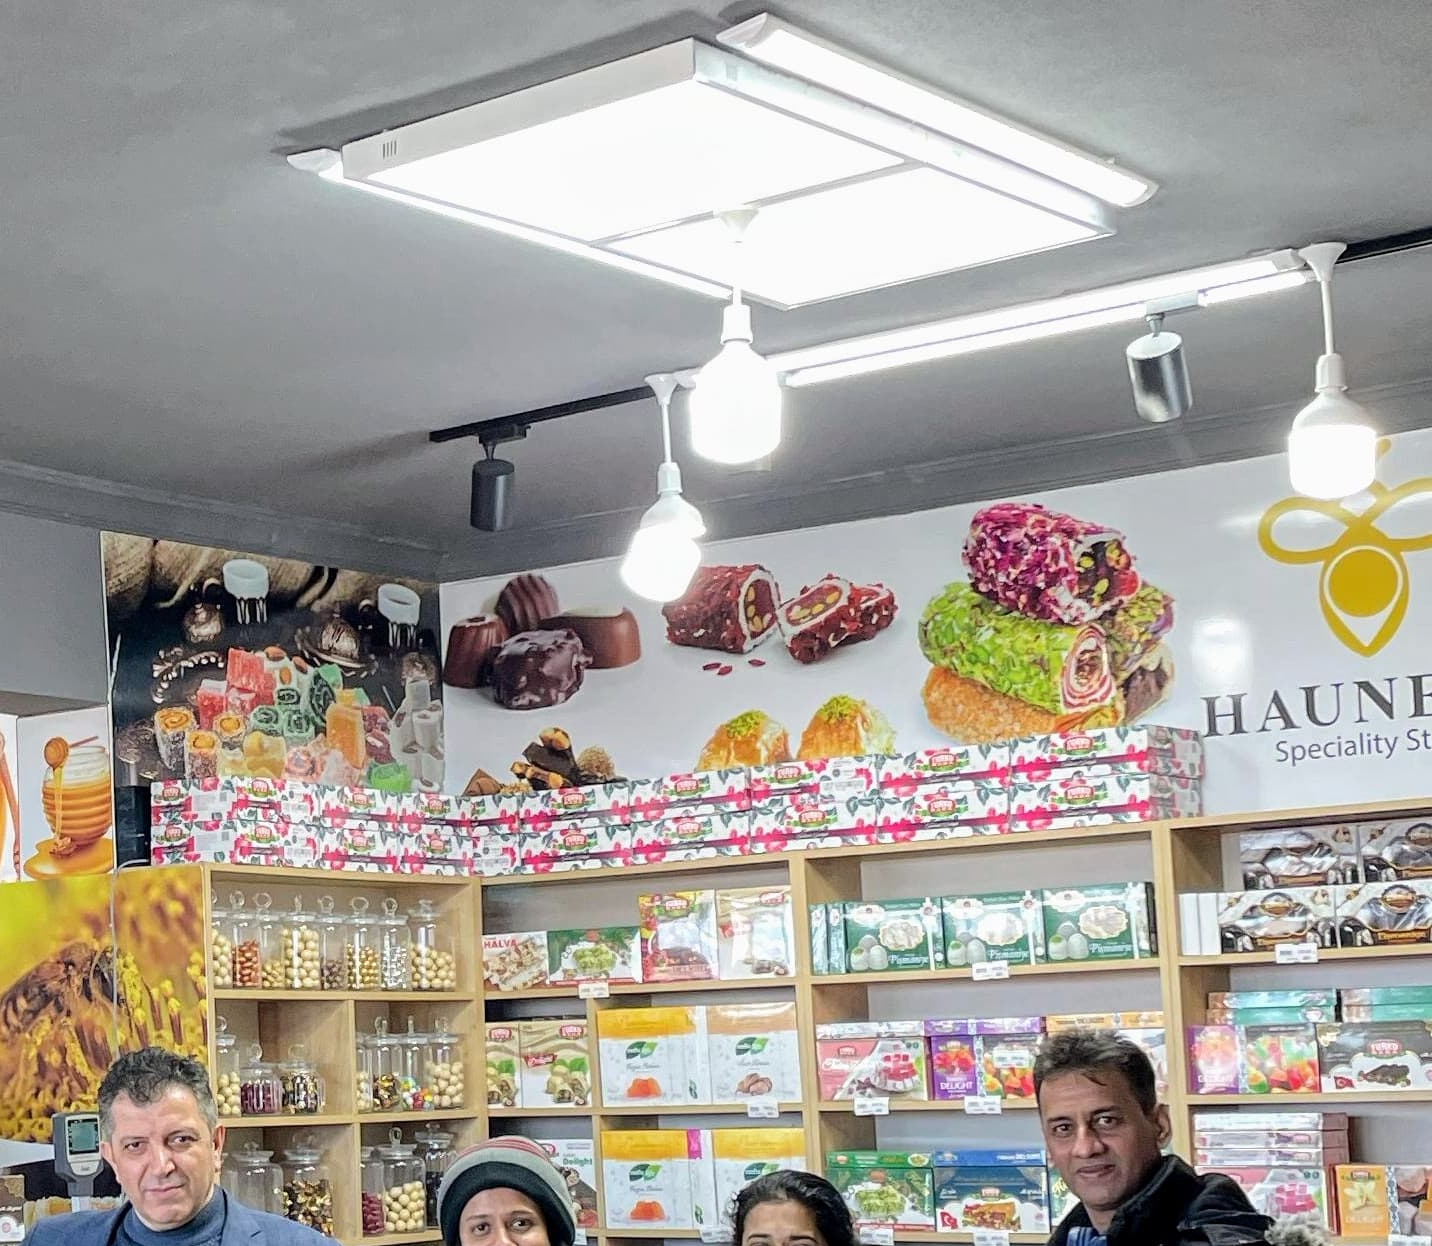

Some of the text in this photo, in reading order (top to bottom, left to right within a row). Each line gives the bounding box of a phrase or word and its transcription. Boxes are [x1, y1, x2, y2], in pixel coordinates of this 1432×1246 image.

[1275, 733, 1399, 767] Speciality
[483, 938, 518, 949] HALVA
[939, 1080, 975, 1090] DELIGHT
